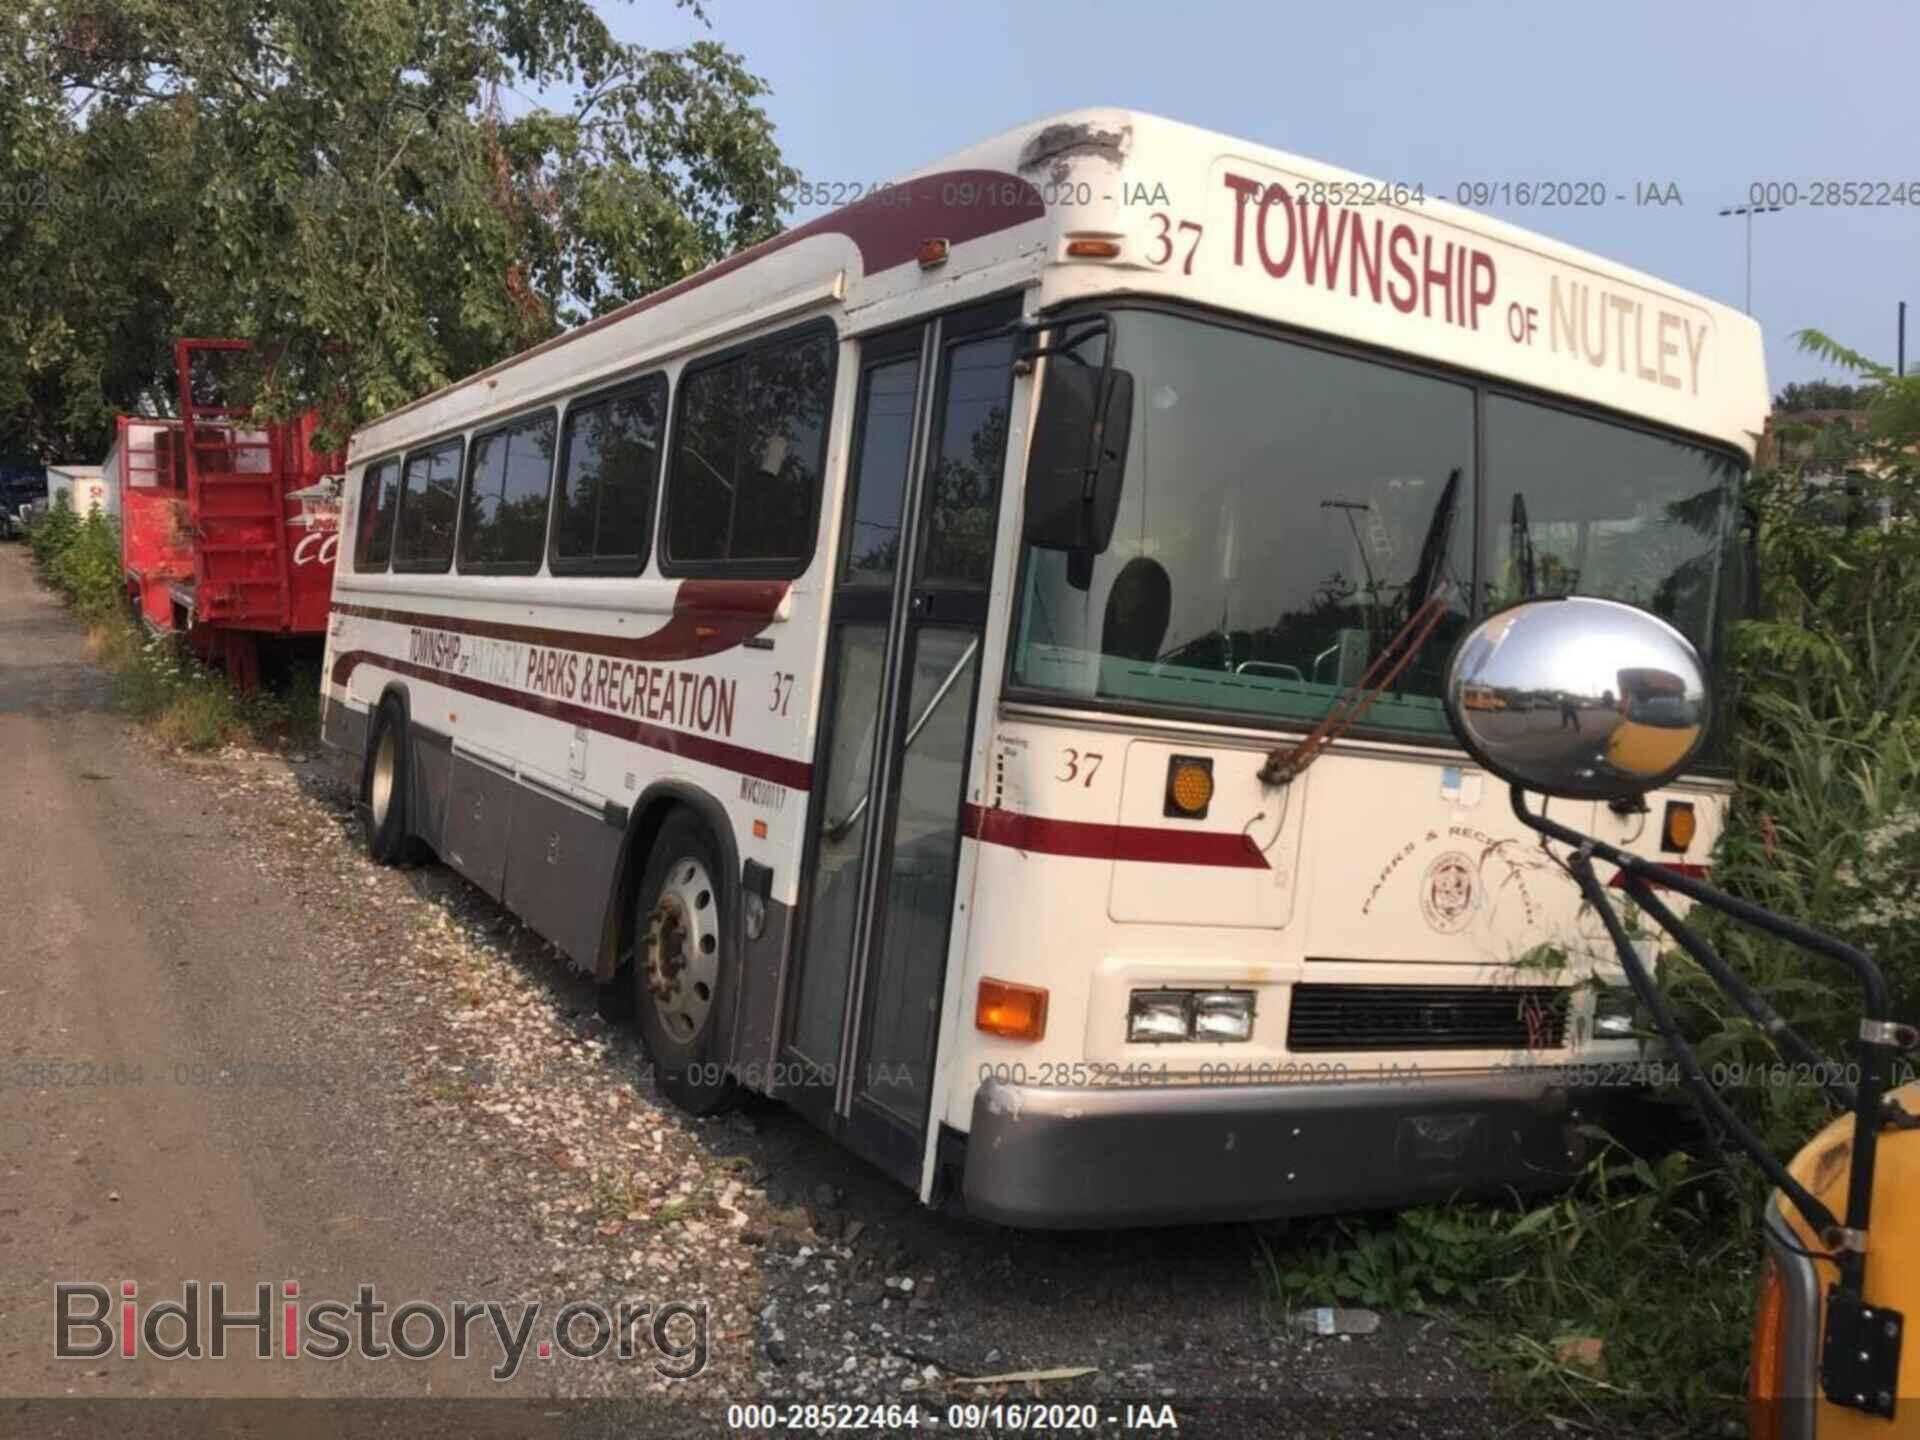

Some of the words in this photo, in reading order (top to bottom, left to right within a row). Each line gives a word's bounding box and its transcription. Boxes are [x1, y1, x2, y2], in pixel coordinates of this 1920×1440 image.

[1146, 211, 1203, 276] 37
[1224, 172, 1497, 331] TOWNSHIP
[1507, 302, 1538, 345] OF
[1550, 275, 1708, 396] NUTLEY
[410, 627, 461, 671] TOWNSHIP
[525, 647, 578, 699] PARKS
[580, 657, 593, 704] &
[594, 659, 737, 737] RECREATION
[768, 671, 795, 717] 37
[1055, 747, 1104, 788] 37
